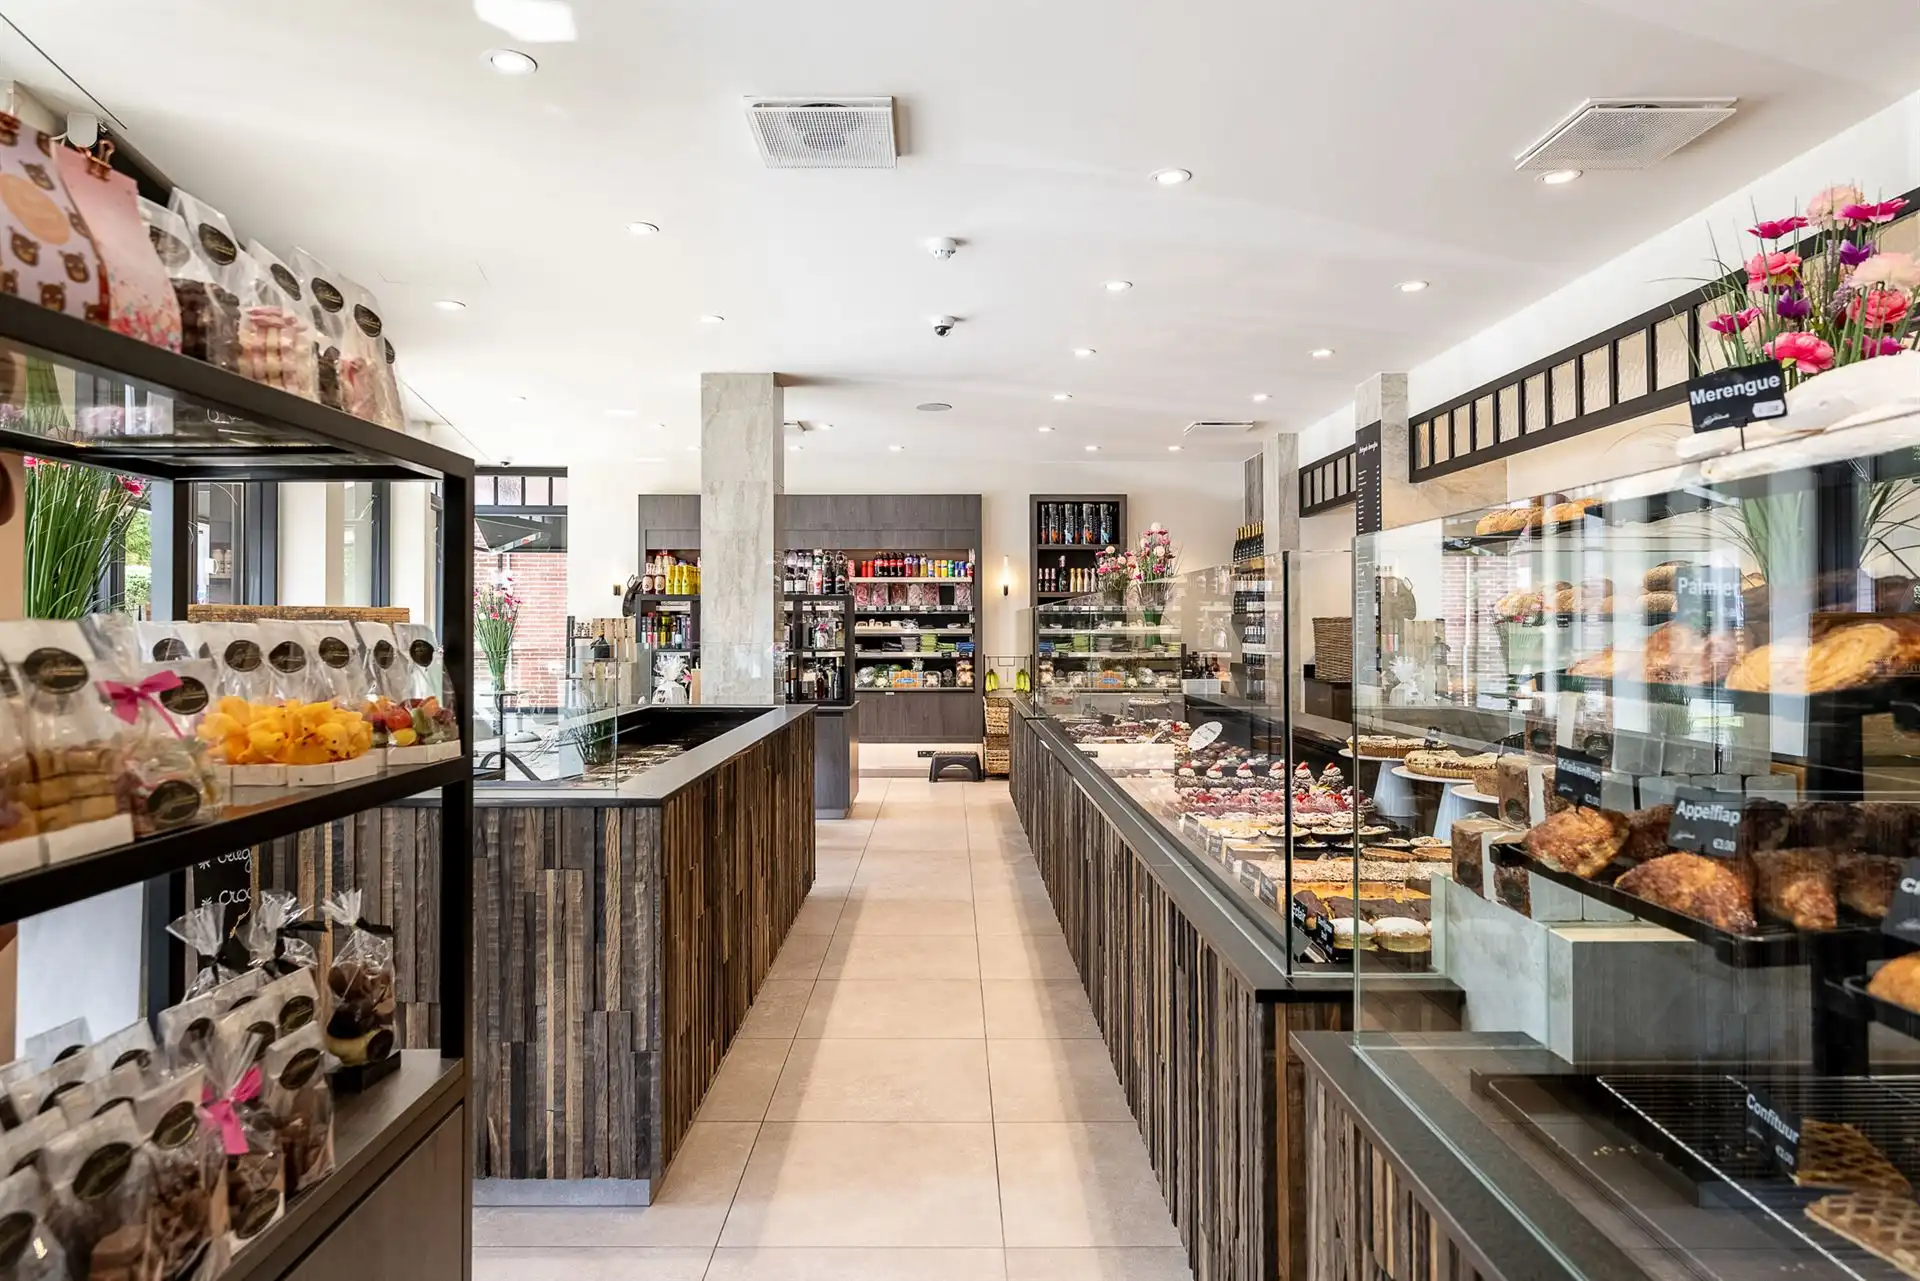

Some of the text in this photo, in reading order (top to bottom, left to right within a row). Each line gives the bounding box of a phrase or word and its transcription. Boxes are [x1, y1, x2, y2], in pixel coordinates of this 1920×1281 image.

[1690, 374, 1781, 406] Merengue
[1675, 799, 1741, 827] Appelflap
[1746, 1093, 1799, 1144] Confituur
